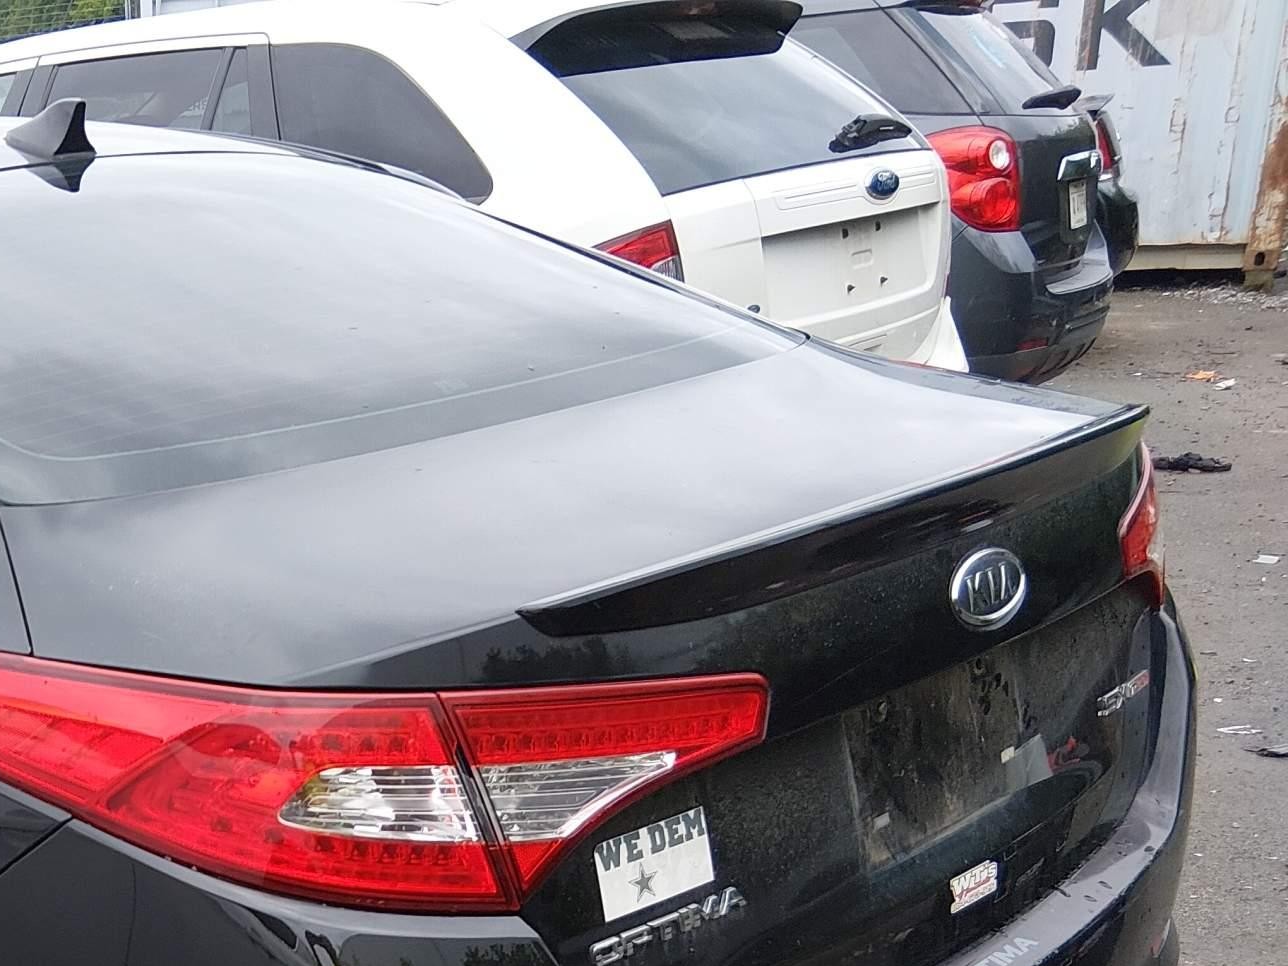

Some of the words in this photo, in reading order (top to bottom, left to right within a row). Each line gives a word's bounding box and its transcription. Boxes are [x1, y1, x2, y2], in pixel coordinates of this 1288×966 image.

[963, 561, 1016, 613] KIA
[595, 830, 644, 872] WE
[647, 807, 706, 855] DEM
